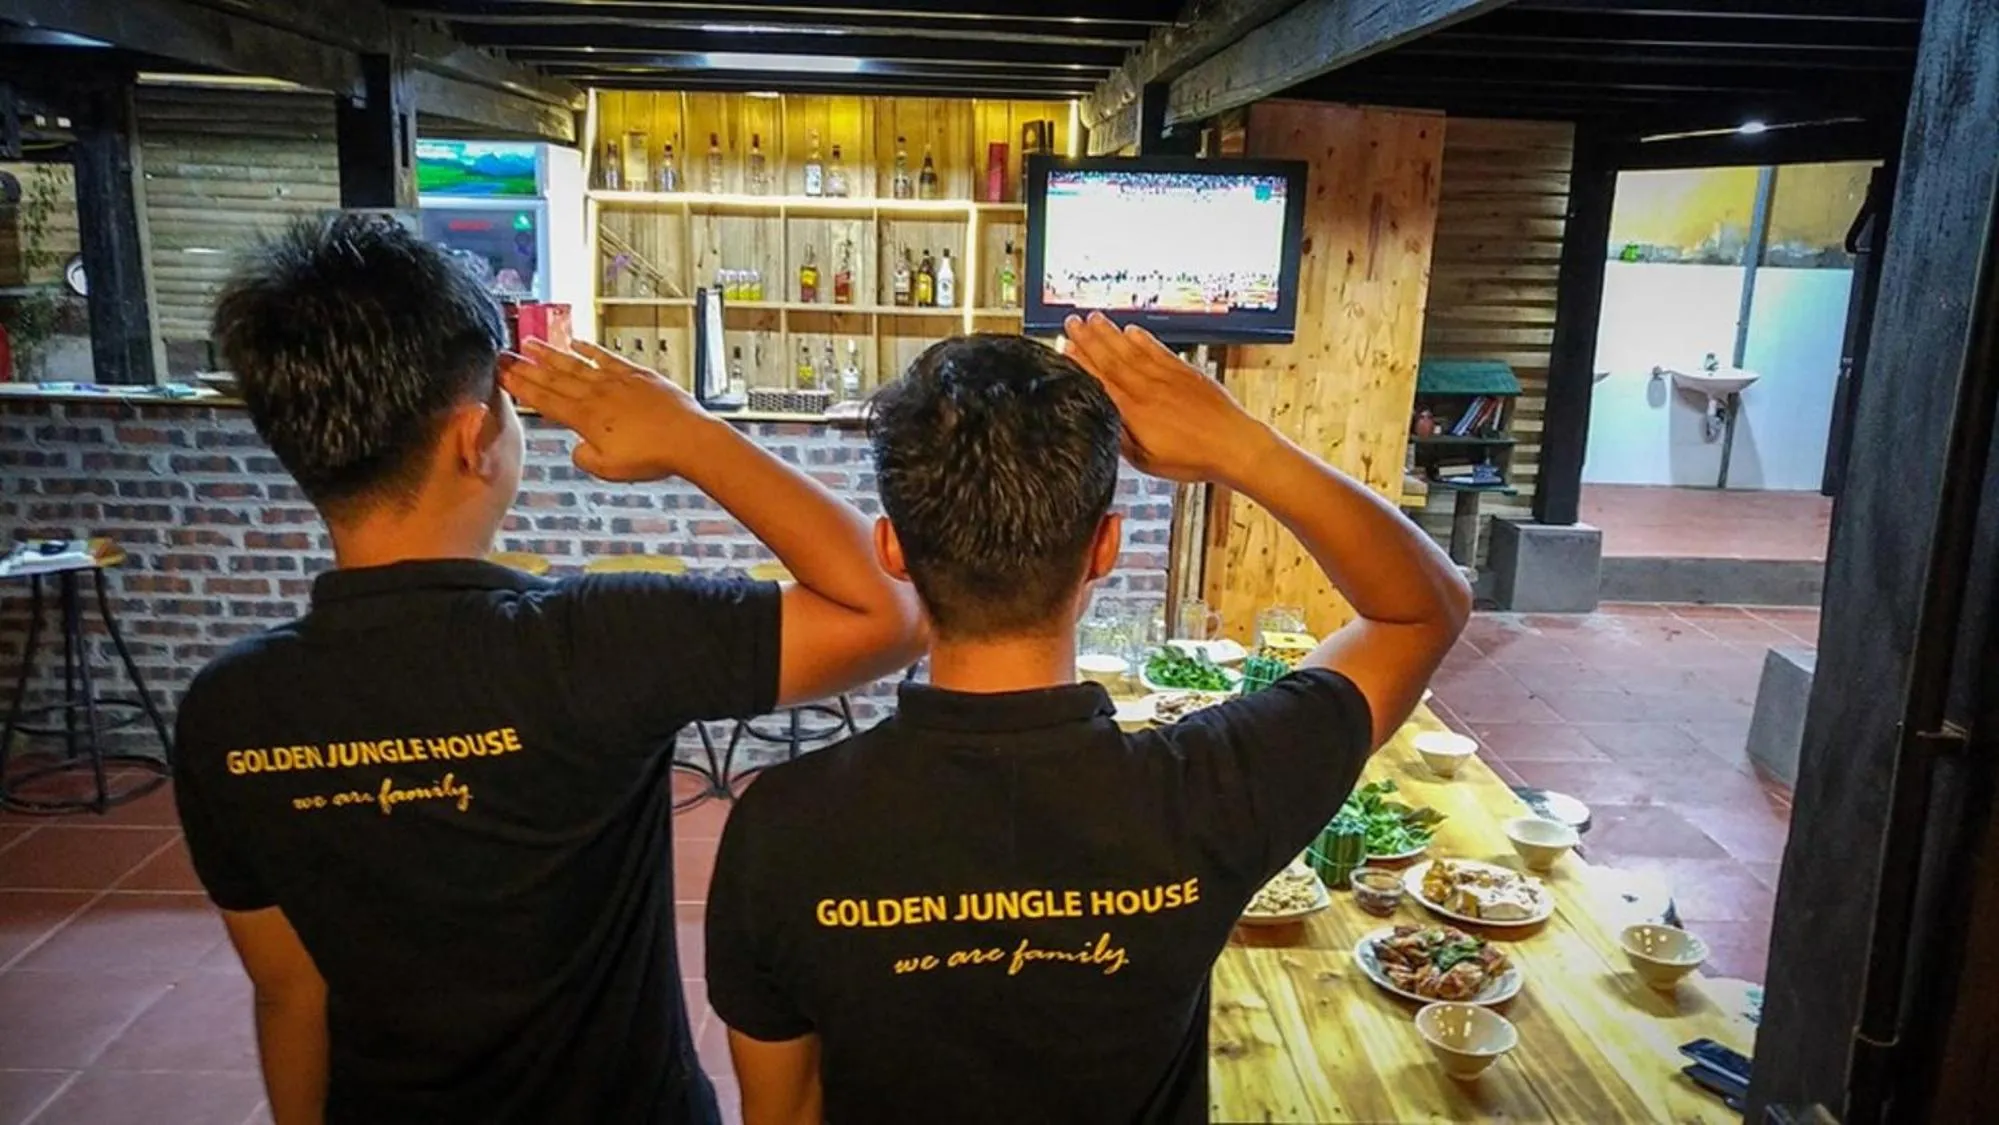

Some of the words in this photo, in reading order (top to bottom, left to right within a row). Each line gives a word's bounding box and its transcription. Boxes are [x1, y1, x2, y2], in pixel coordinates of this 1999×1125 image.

[227, 745, 325, 775] GOLDEN
[326, 738, 429, 769] JUNGLE
[426, 727, 523, 760] HOUSE
[292, 795, 327, 810] we
[332, 791, 375, 806] are
[377, 772, 473, 814] family
[816, 896, 948, 928] GOLDEN
[953, 889, 1084, 922] JUNGLE
[1090, 877, 1200, 916] HOUSE
[893, 955, 939, 974] we
[946, 945, 1005, 968] are
[1007, 931, 1130, 976] family
